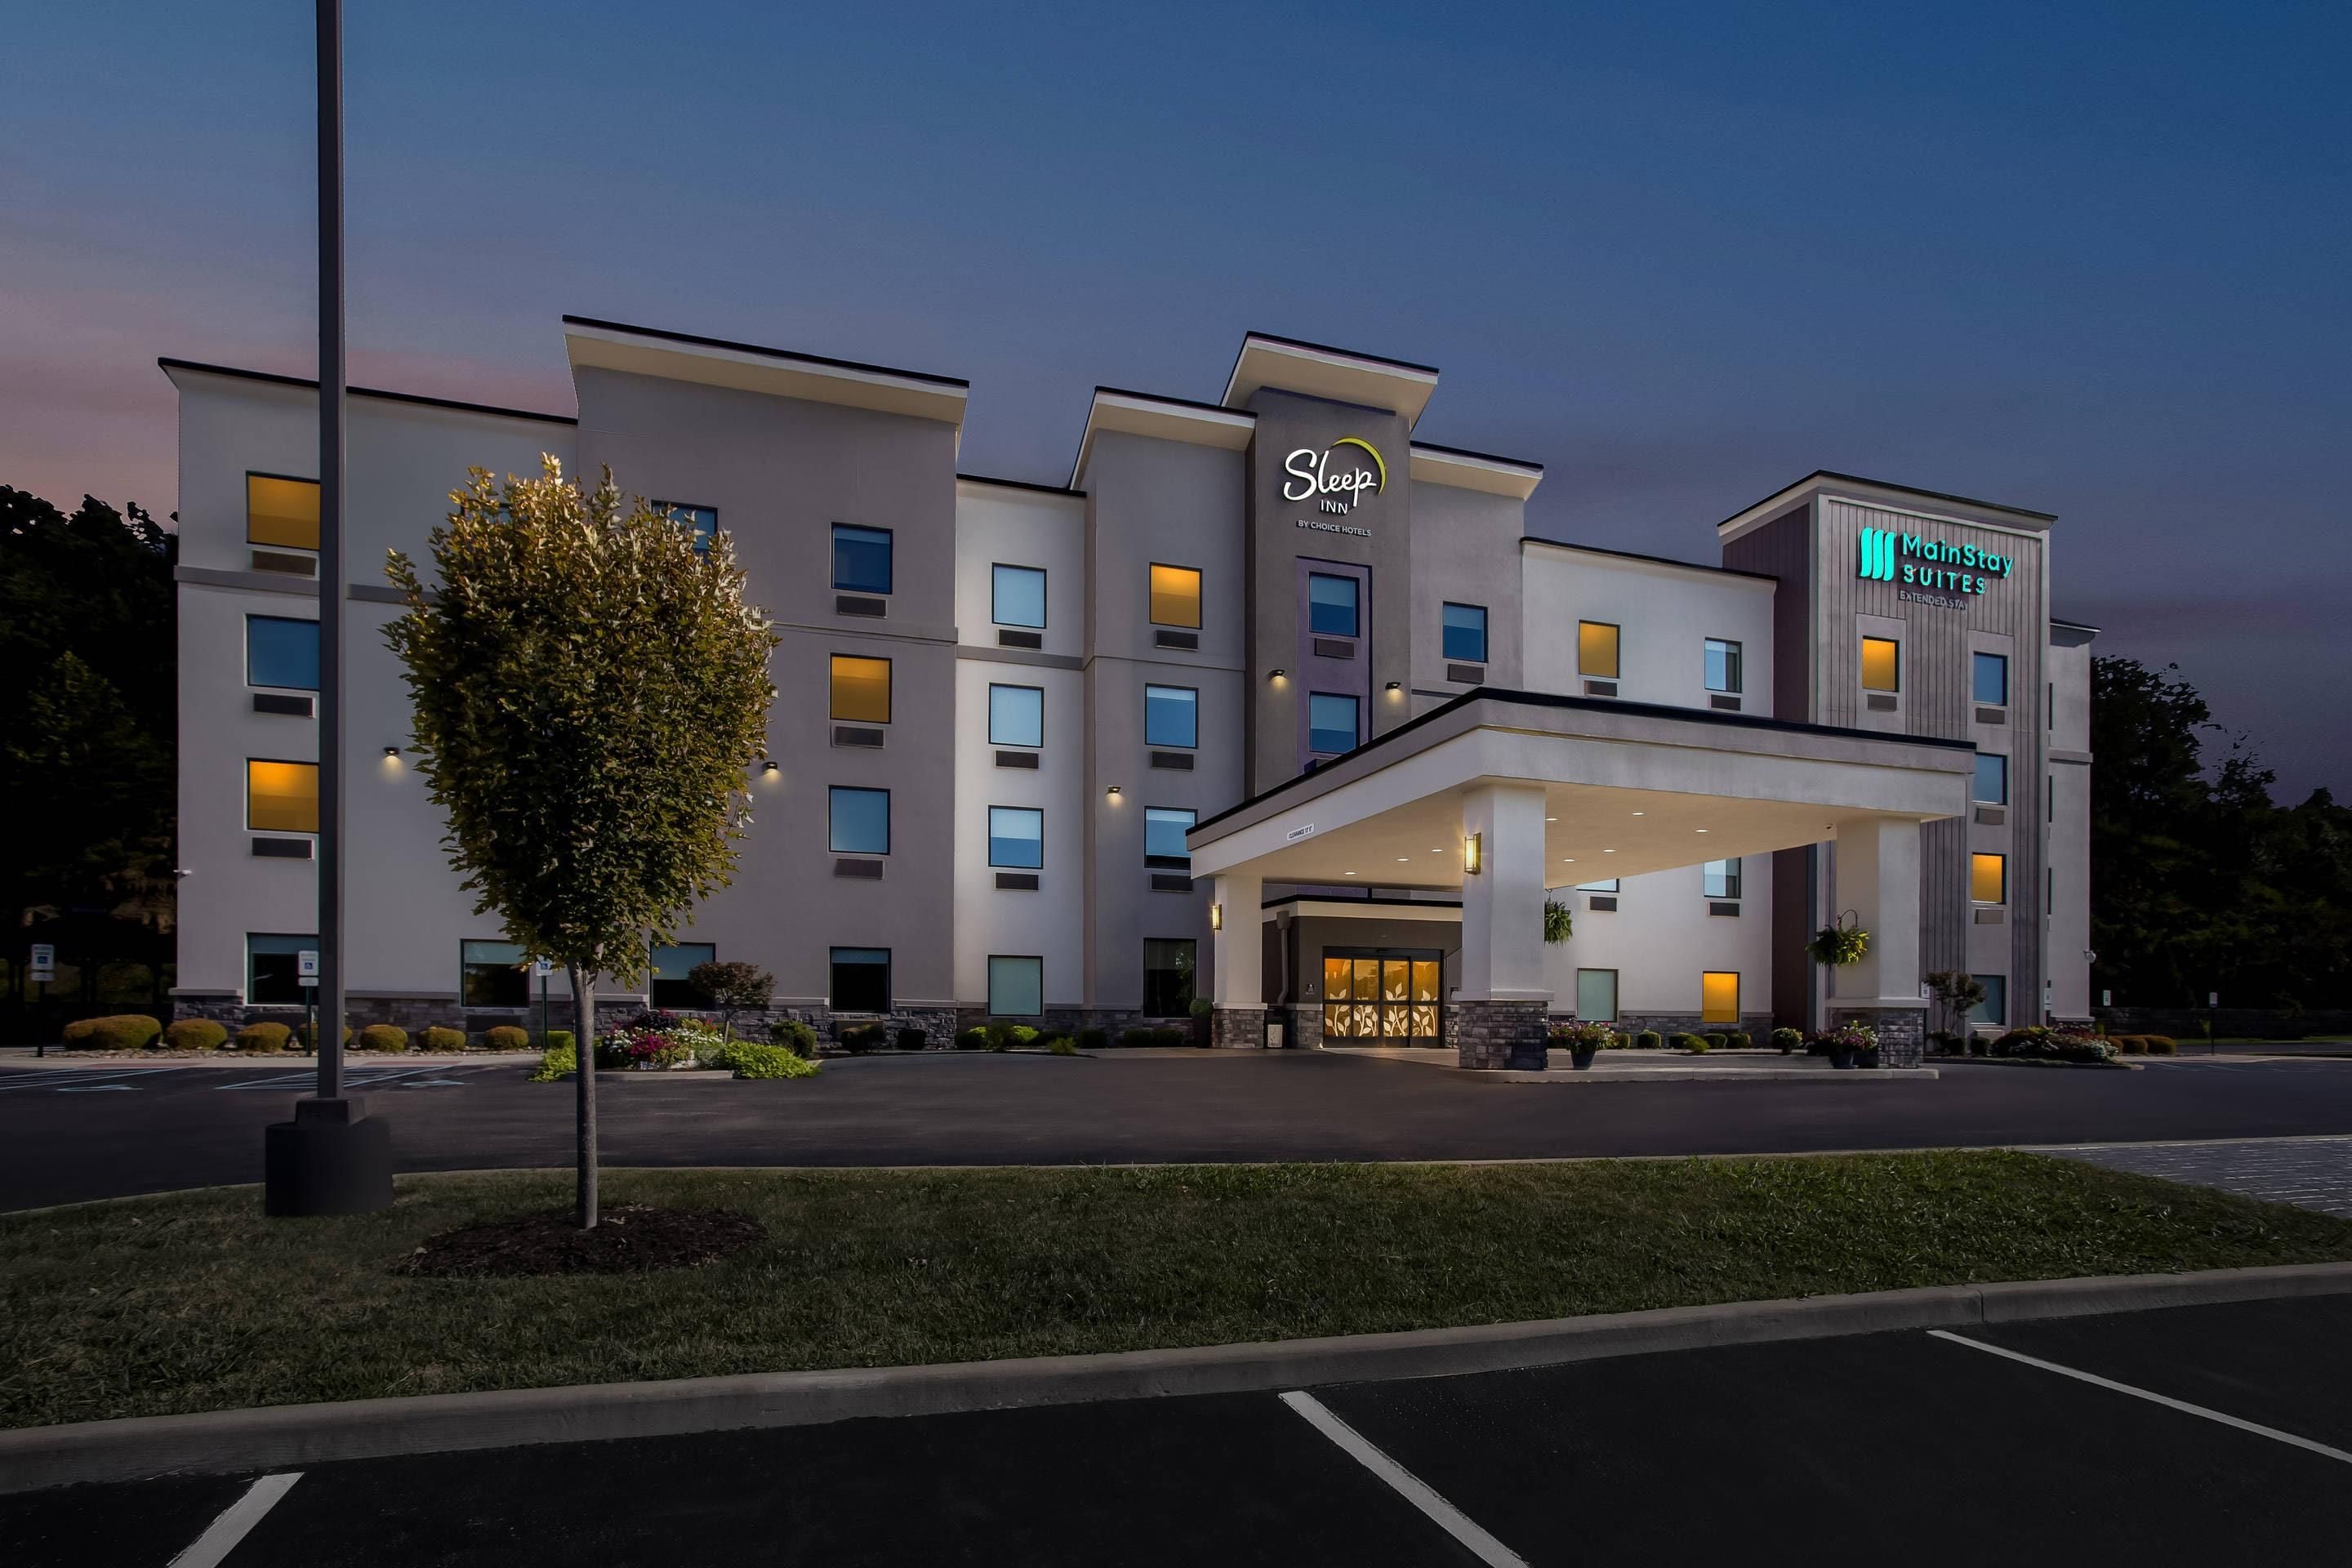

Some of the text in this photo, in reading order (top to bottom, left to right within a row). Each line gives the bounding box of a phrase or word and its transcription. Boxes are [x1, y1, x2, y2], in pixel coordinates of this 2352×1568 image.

[1283, 448, 1377, 507] Sleep
[1321, 499, 1348, 514] INN
[1298, 519, 1372, 537] BY CHOICE HOTELS
[1903, 532, 2014, 579] MainStay
[1903, 564, 1987, 595] SUITES
[1900, 590, 1968, 610] EXTENDED STAY
